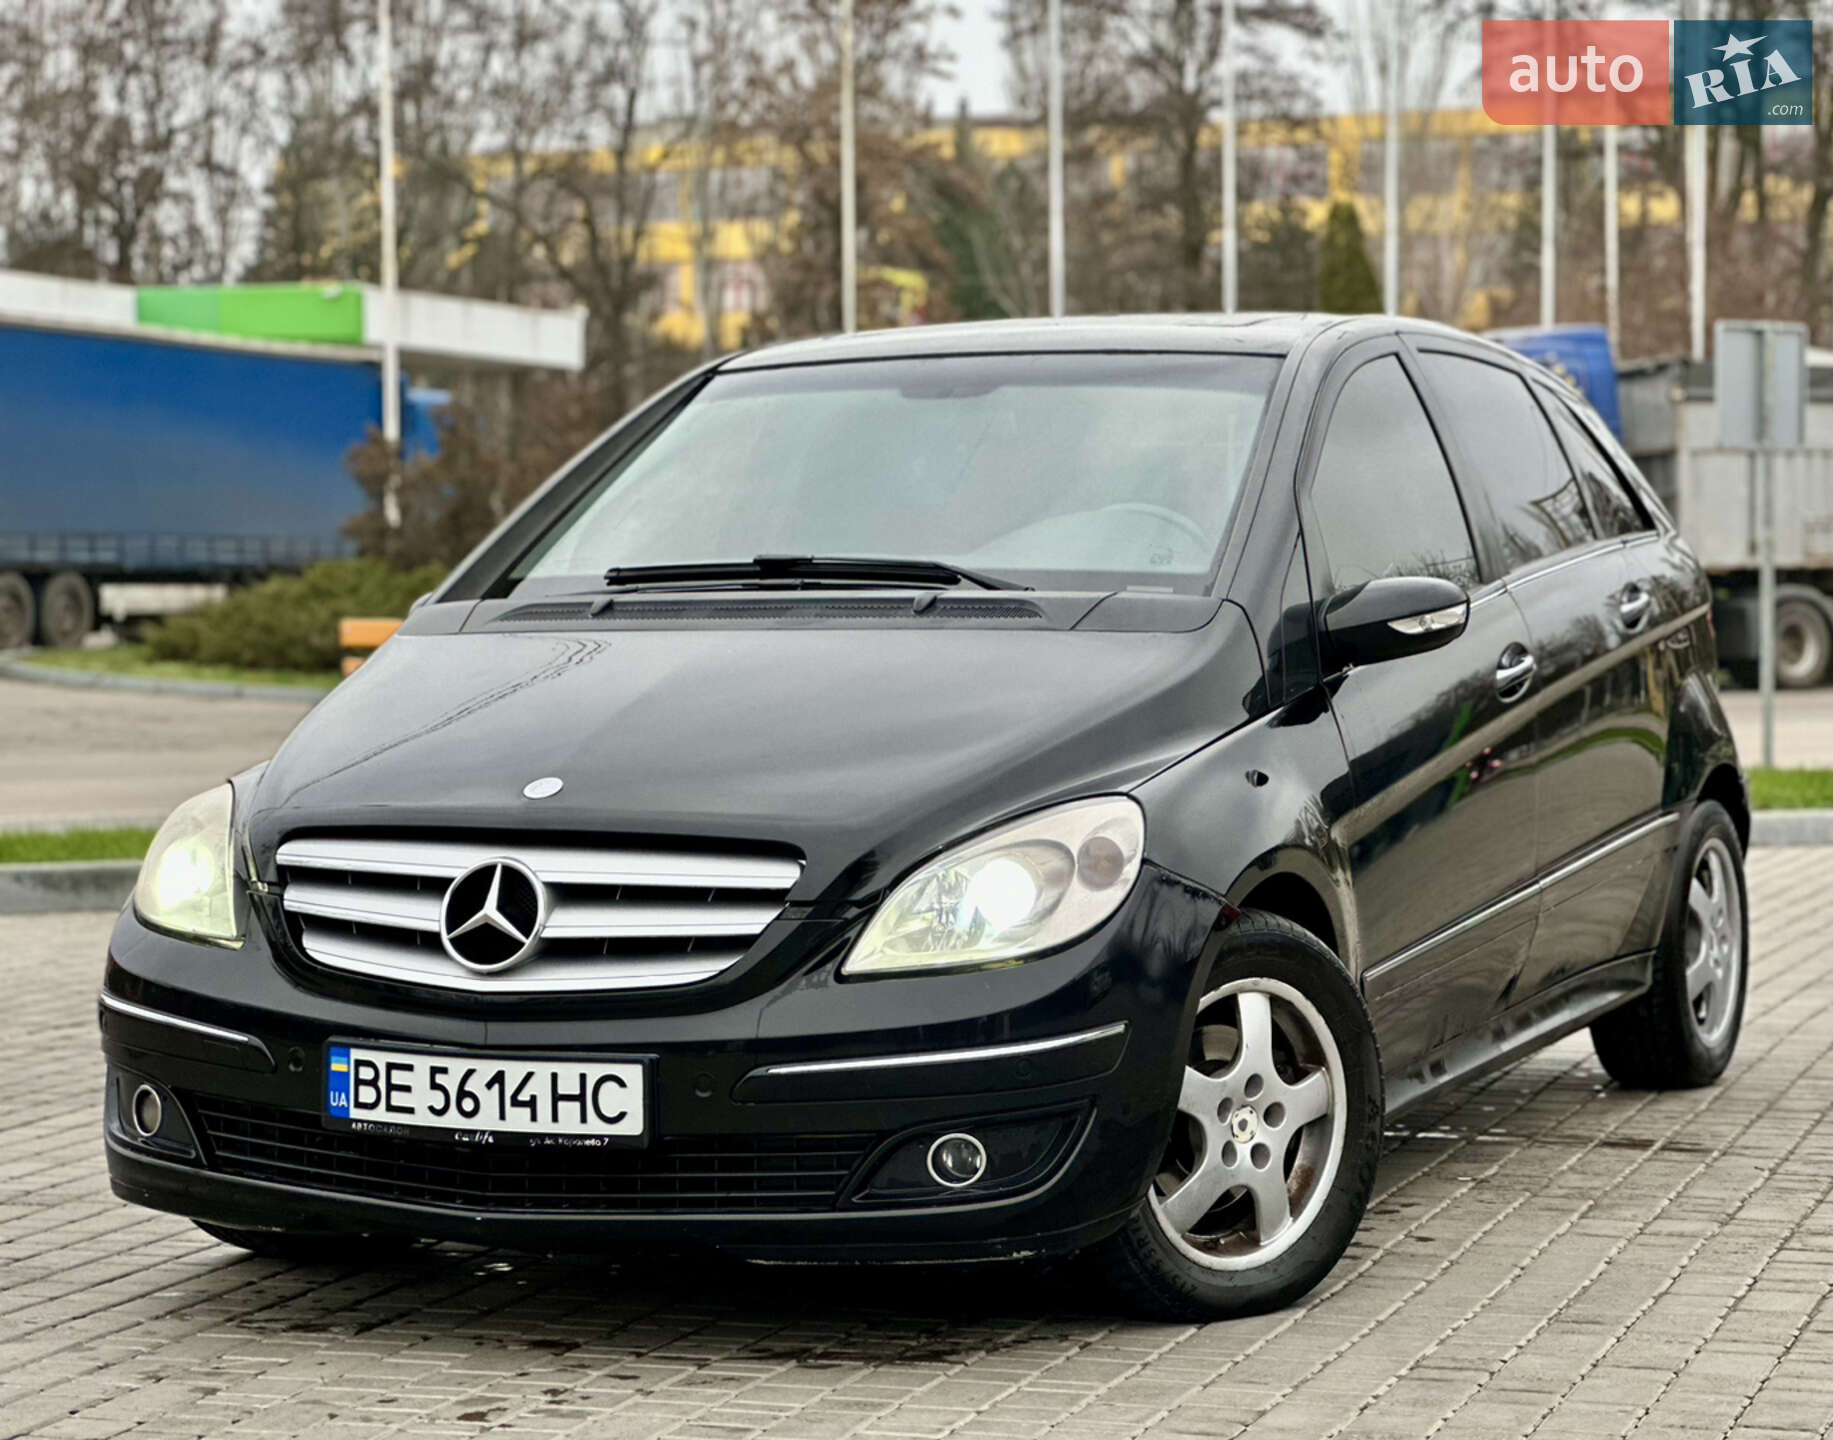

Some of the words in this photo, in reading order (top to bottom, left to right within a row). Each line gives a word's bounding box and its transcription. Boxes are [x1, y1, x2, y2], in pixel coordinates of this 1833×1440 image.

[330, 1092, 348, 1107] UA
[353, 1059, 415, 1115] BE
[427, 1066, 537, 1122] 5614
[551, 1072, 628, 1124] HC
